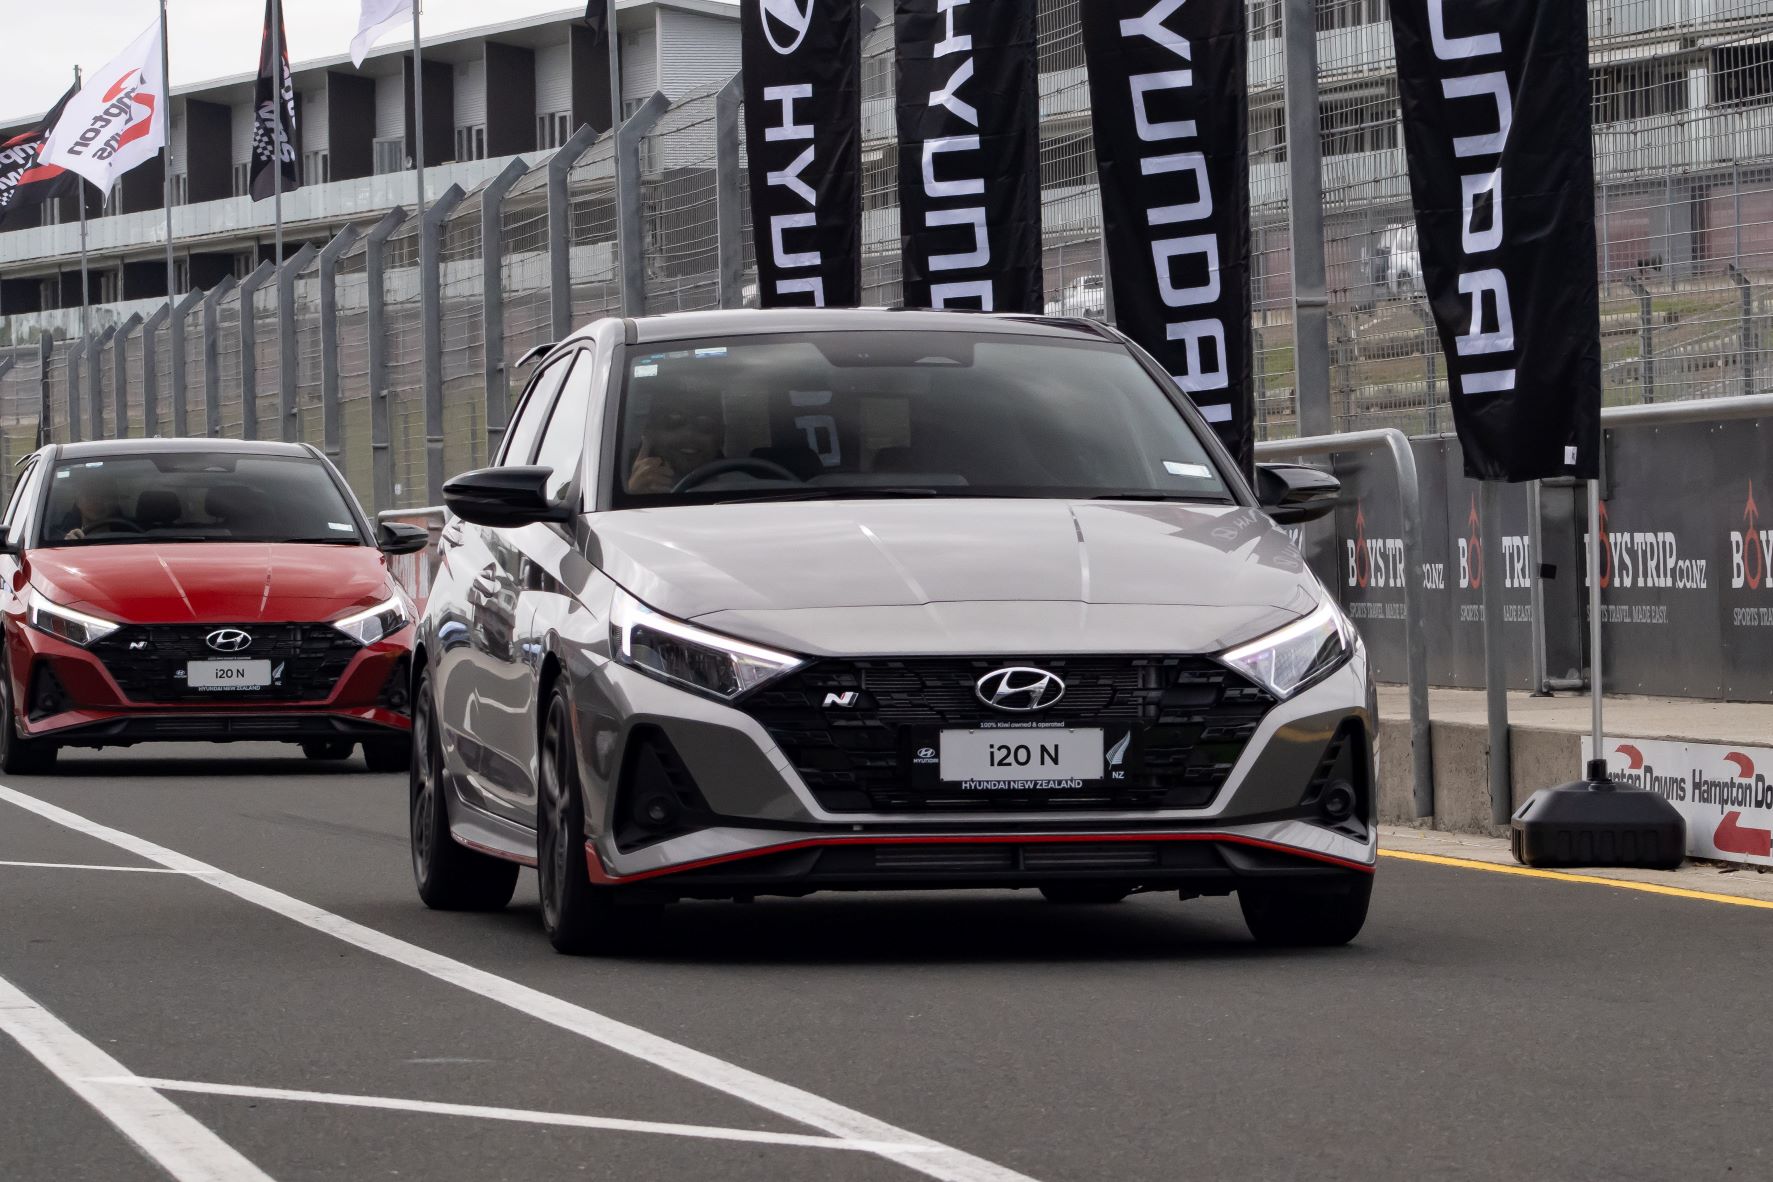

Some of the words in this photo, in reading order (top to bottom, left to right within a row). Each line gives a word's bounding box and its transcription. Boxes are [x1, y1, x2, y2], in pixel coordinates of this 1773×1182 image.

[215, 668, 234, 679] i20
[236, 668, 245, 678] N
[989, 744, 1031, 767] i20
[1040, 744, 1059, 766] N
[1112, 771, 1125, 779] NZ
[962, 781, 1009, 790] HYUNDAI
[1010, 781, 1035, 789] NEW
[1036, 780, 1083, 788] ZEALAND
[1691, 769, 1753, 815] Hampton
